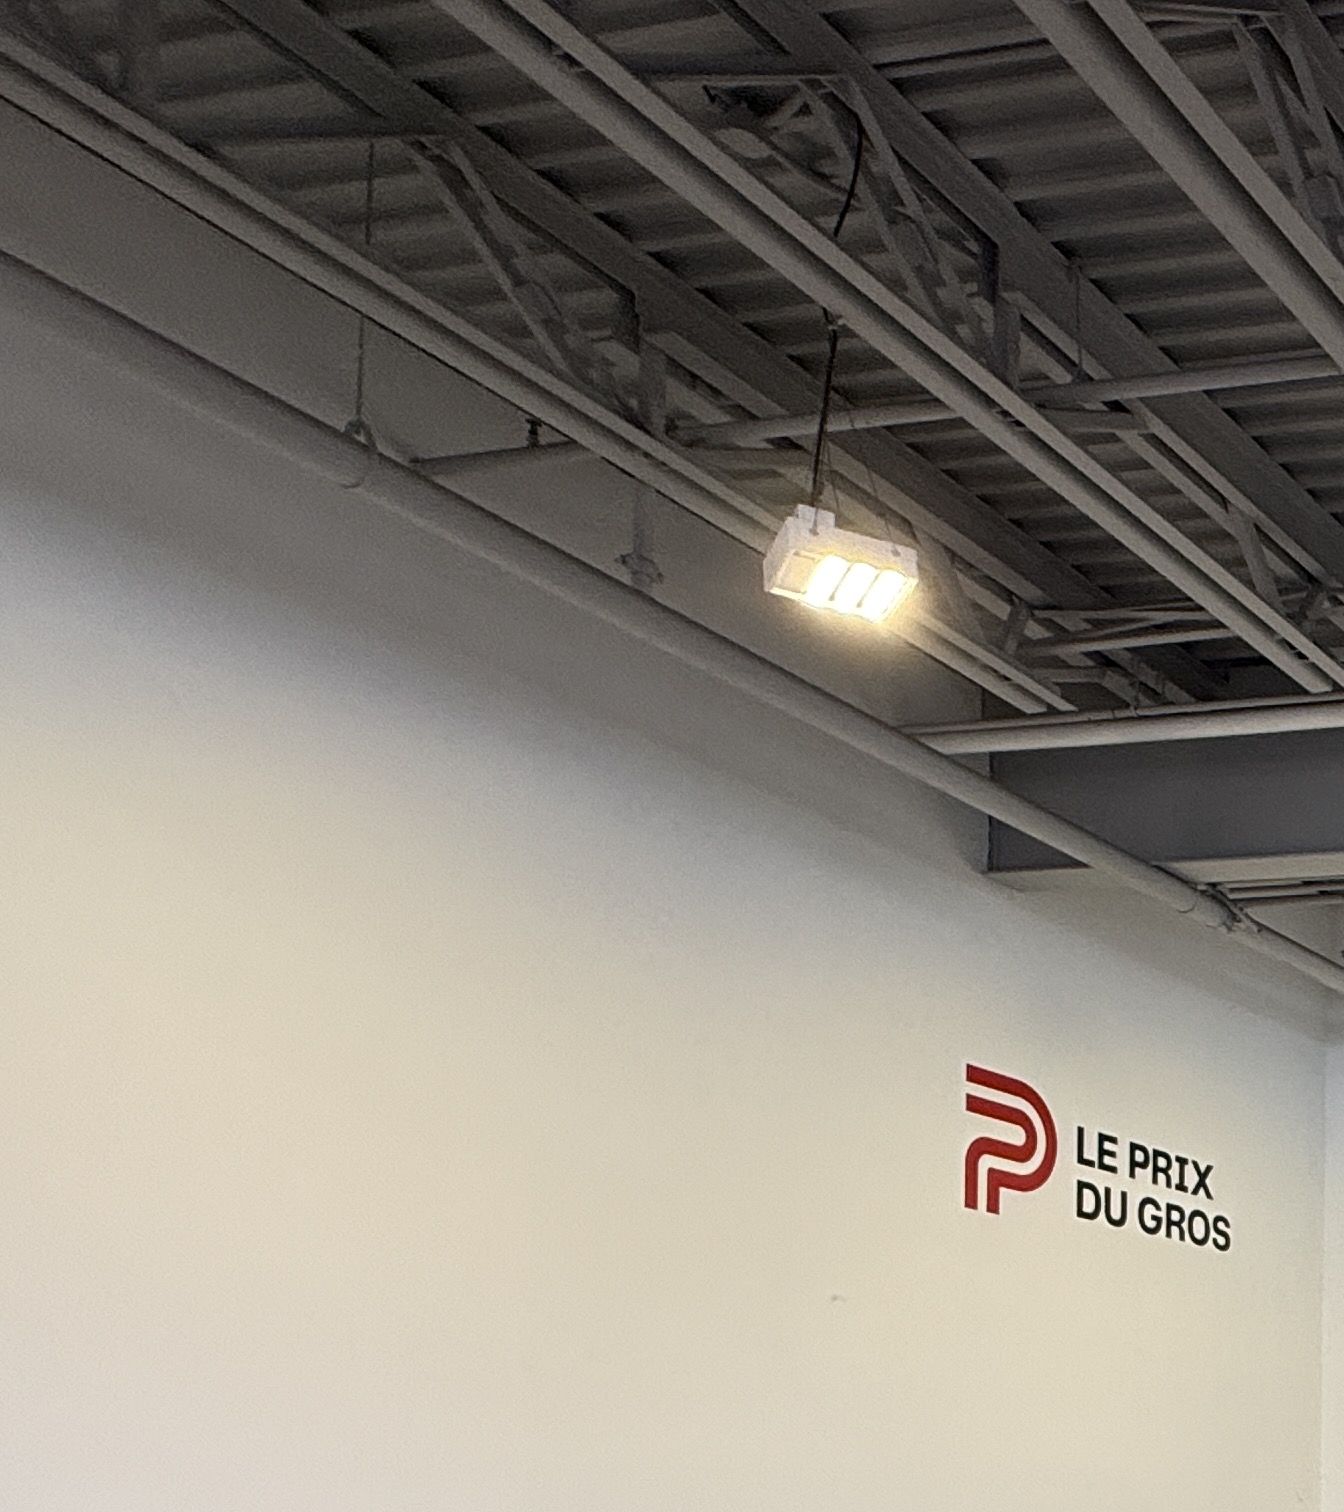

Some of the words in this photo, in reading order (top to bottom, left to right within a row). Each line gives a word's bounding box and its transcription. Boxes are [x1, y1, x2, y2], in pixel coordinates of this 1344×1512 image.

[1076, 1125, 1118, 1175] LE
[1128, 1141, 1214, 1201] PRIX
[1076, 1179, 1128, 1228] DU
[1137, 1196, 1232, 1253] GROS
